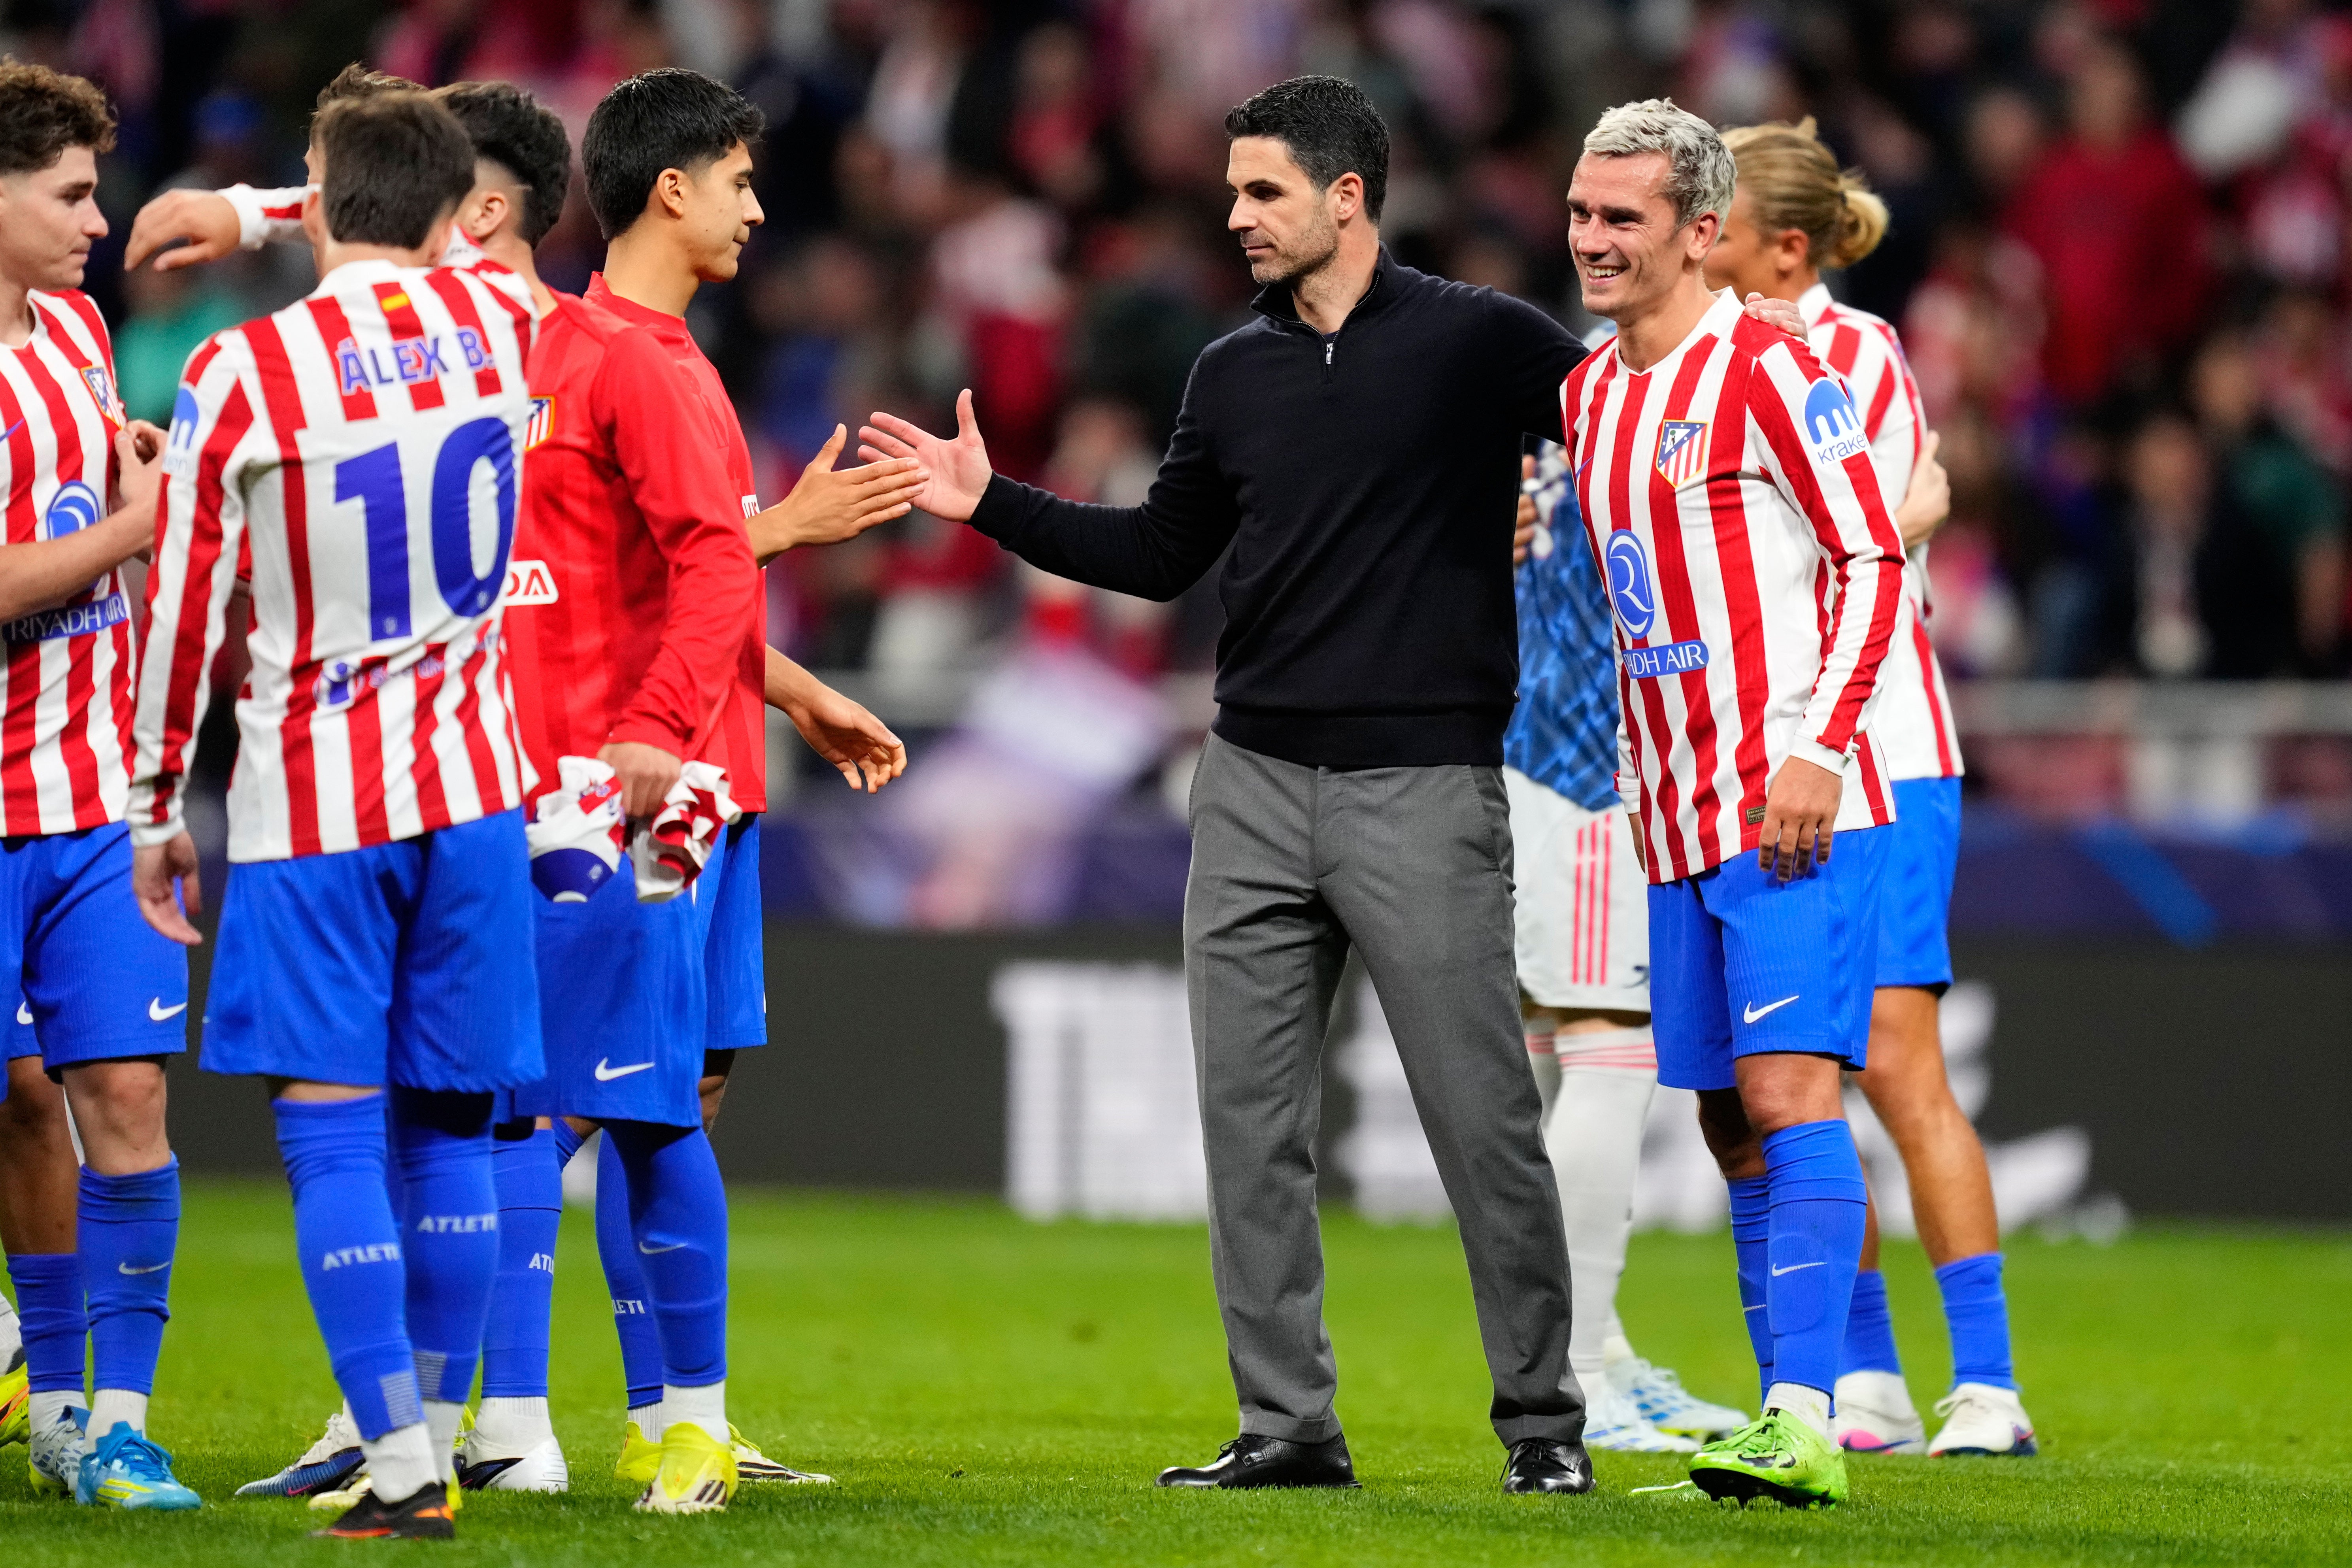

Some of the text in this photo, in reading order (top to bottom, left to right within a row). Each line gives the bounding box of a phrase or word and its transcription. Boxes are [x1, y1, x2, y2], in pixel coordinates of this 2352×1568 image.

[339, 329, 496, 392] ÁLEX B.
[334, 417, 515, 642] 10
[11, 605, 102, 641] RIYADH
[1623, 644, 1705, 675] ADH AIR
[417, 1213, 497, 1233] ATLETI
[322, 1242, 402, 1271] ATLETI
[612, 1299, 645, 1314] LETI
